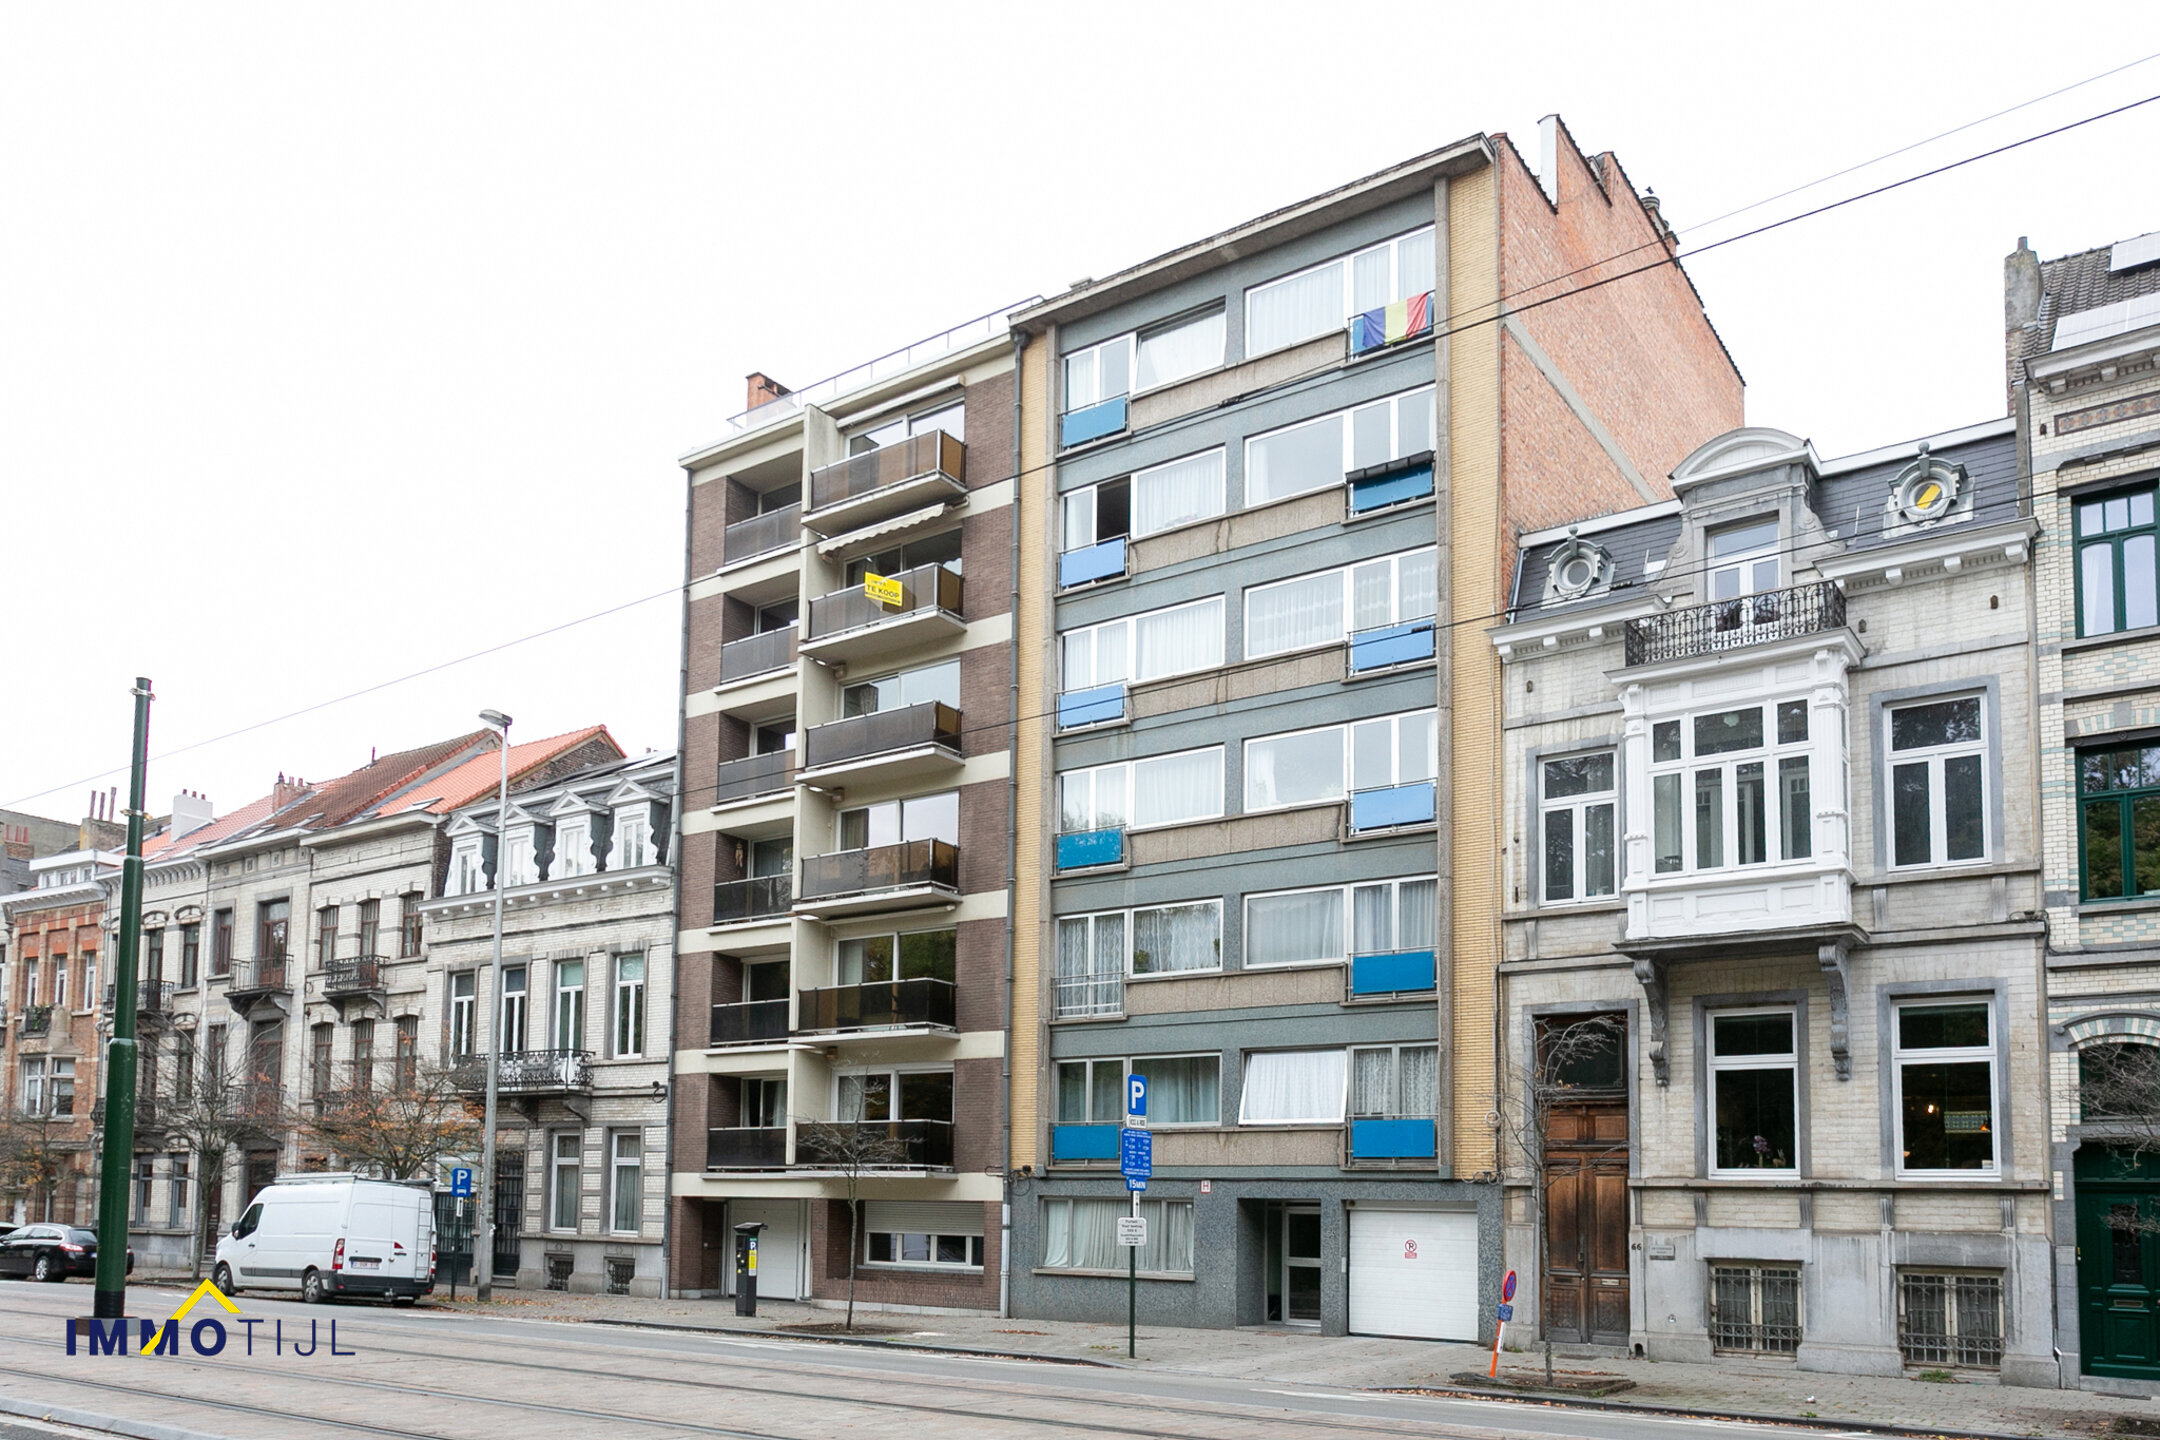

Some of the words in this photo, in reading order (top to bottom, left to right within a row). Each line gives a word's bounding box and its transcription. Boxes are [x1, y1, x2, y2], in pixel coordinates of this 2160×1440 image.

[867, 585, 876, 593] TE
[878, 589, 900, 598] KOOP
[1131, 1080, 1144, 1109] P
[457, 1170, 468, 1185] P
[1631, 1243, 1642, 1251] 66
